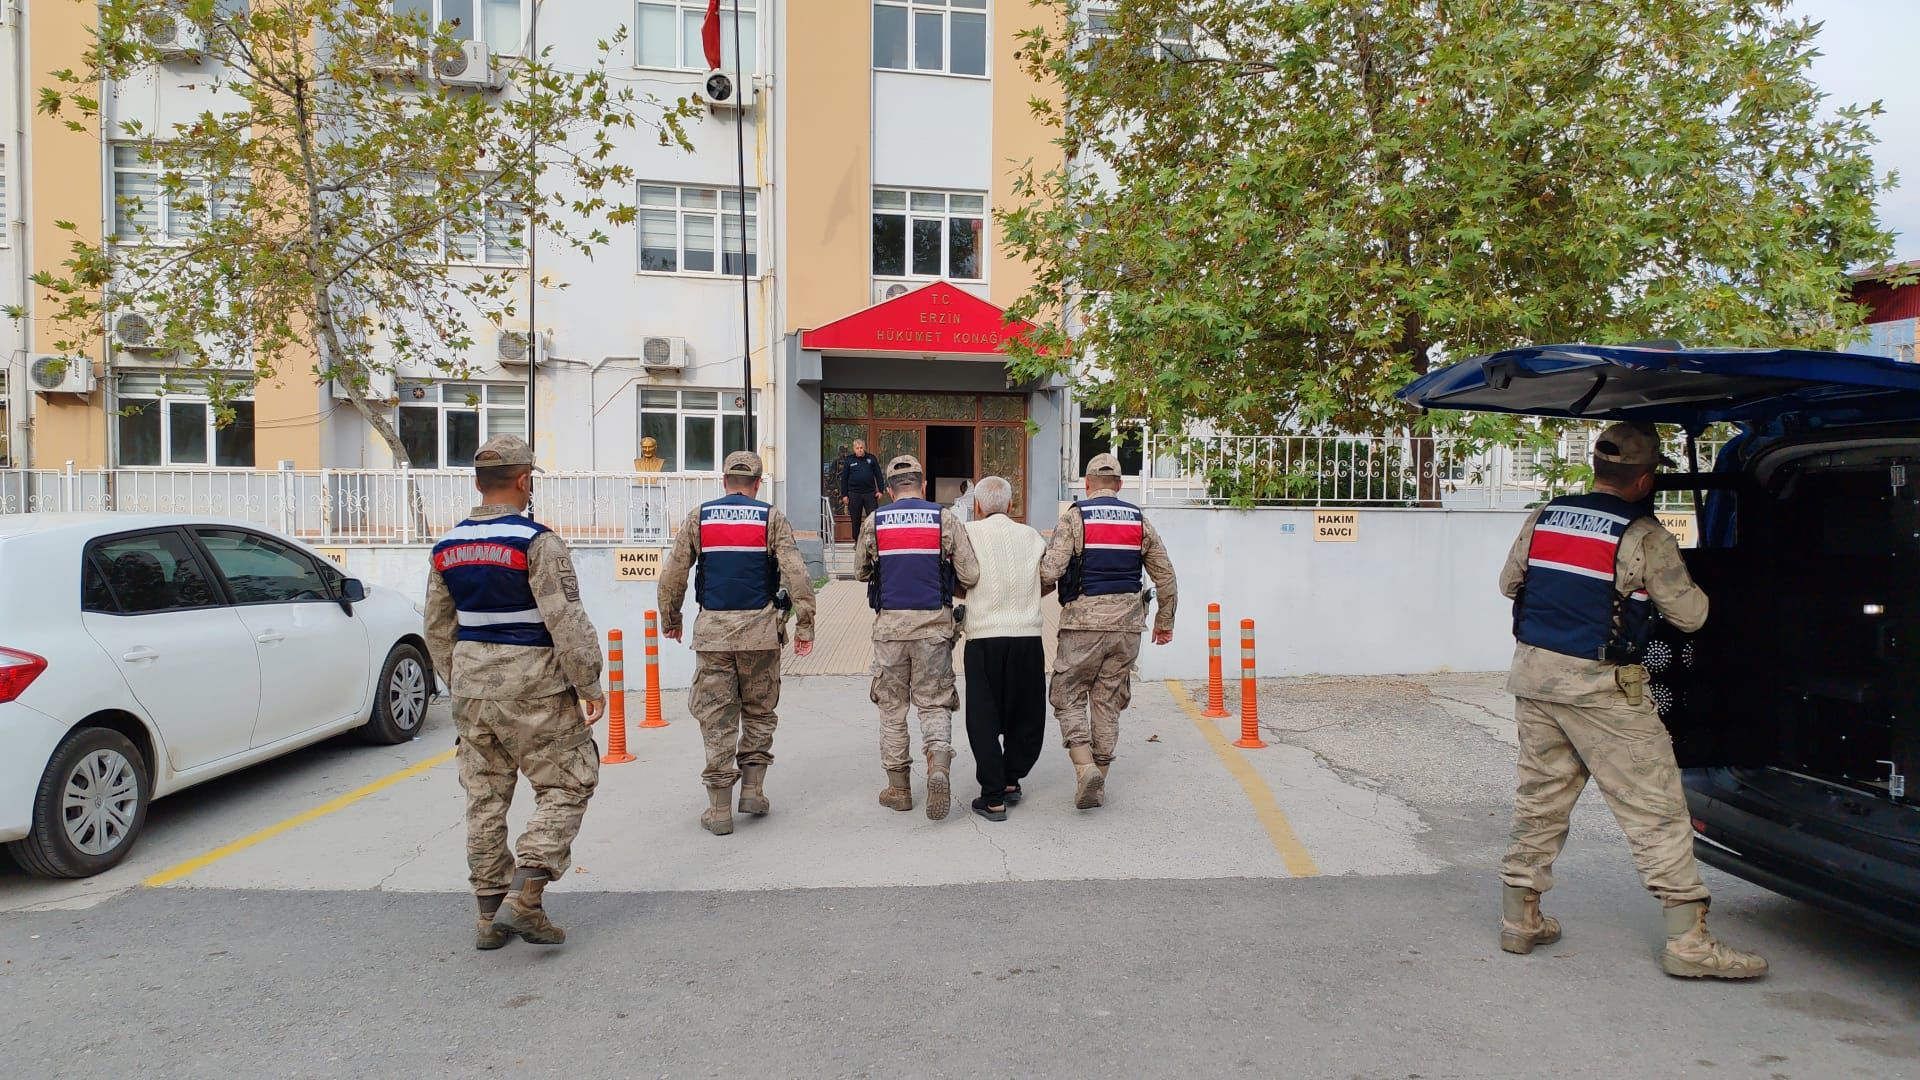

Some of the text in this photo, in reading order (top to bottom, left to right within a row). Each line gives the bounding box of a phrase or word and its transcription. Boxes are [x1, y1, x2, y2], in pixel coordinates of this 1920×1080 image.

[920, 310, 961, 325] ERZİN
[876, 327, 942, 343] HÜKÜMET
[707, 509, 761, 521] JANDARMA
[881, 513, 935, 525] JANDARMA
[1089, 508, 1136, 521] JANDARMA
[1318, 513, 1354, 524] HAKİM
[1545, 510, 1613, 535] JANDARMA
[1661, 517, 1687, 528] AKİM
[1319, 527, 1352, 537] SAVCI
[442, 545, 512, 567] JANDARMA
[620, 551, 659, 562] HAKİM
[622, 567, 656, 576] SAVCI
